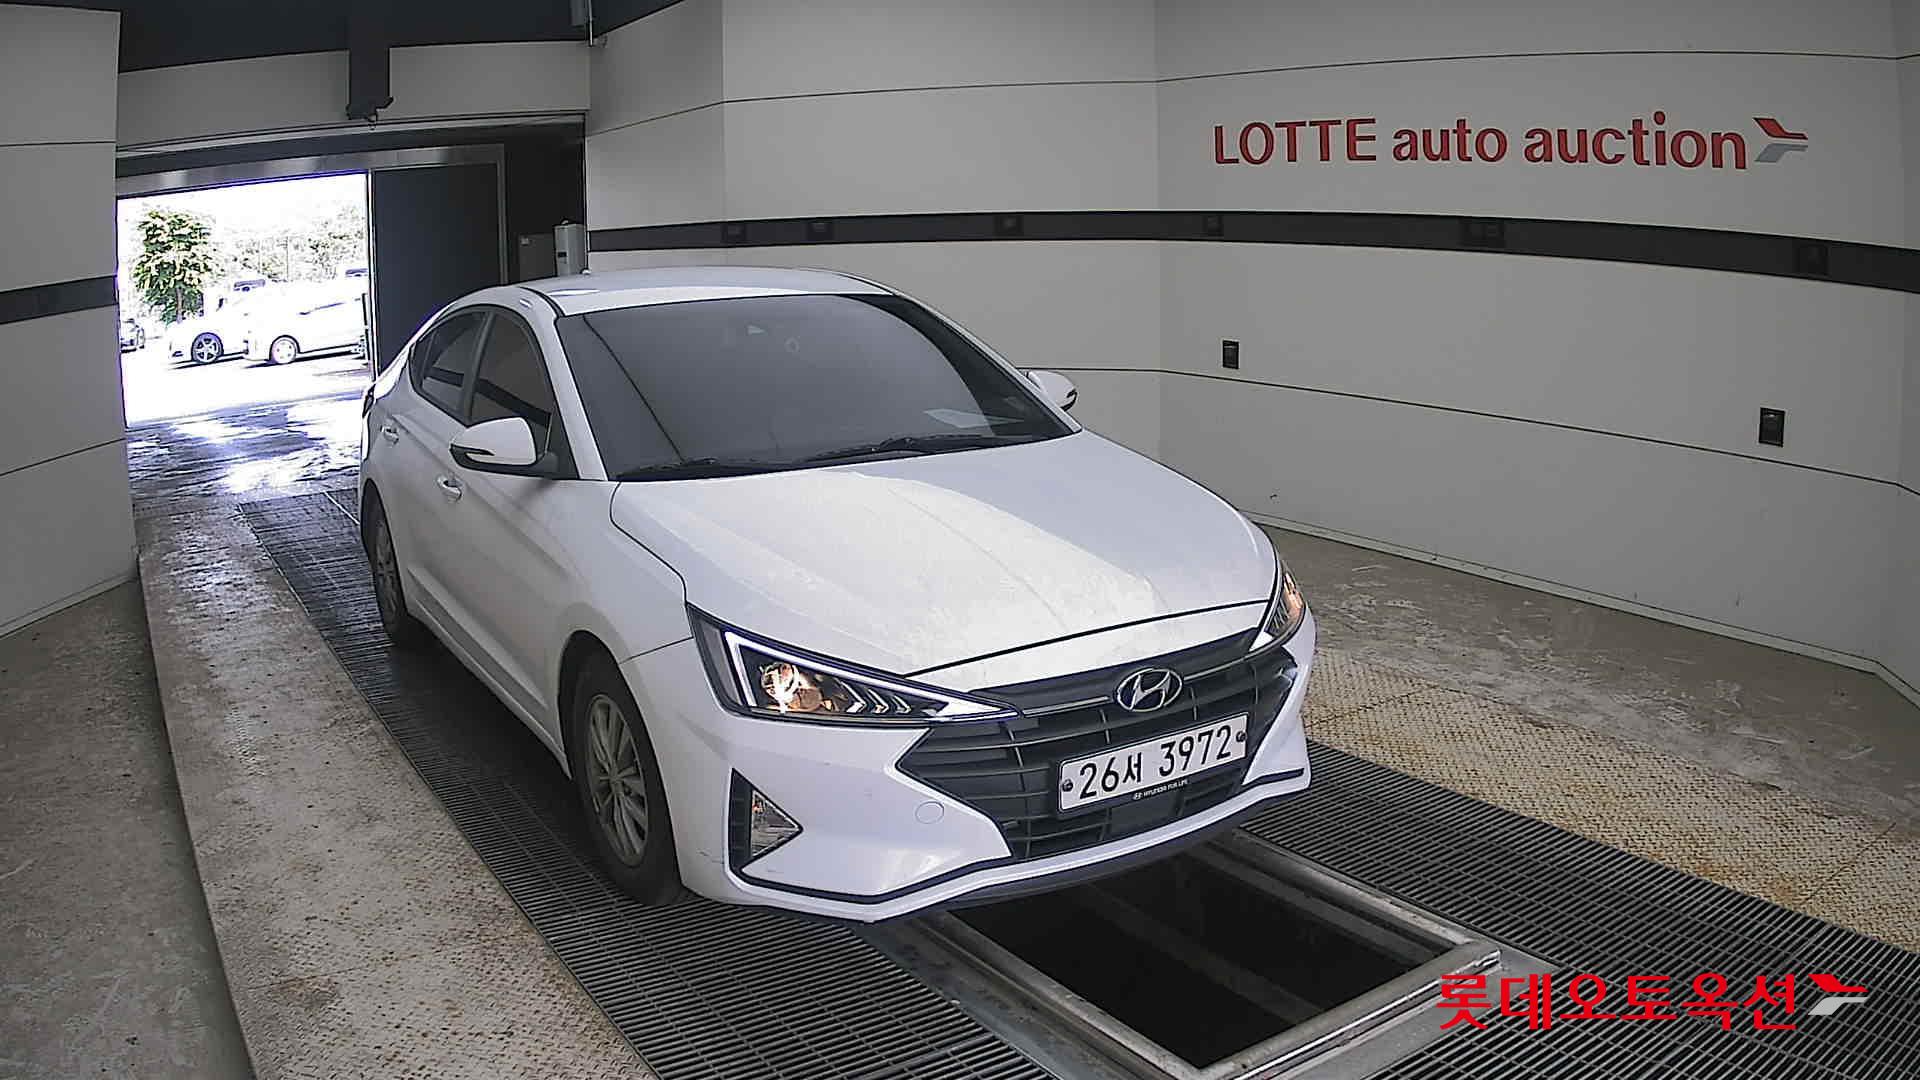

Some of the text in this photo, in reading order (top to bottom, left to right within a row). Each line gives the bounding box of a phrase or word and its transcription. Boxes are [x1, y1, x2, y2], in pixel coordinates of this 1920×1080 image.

[1214, 111, 1747, 169] LOTTE auto auction
[1079, 725, 1232, 800] 26서 3972
